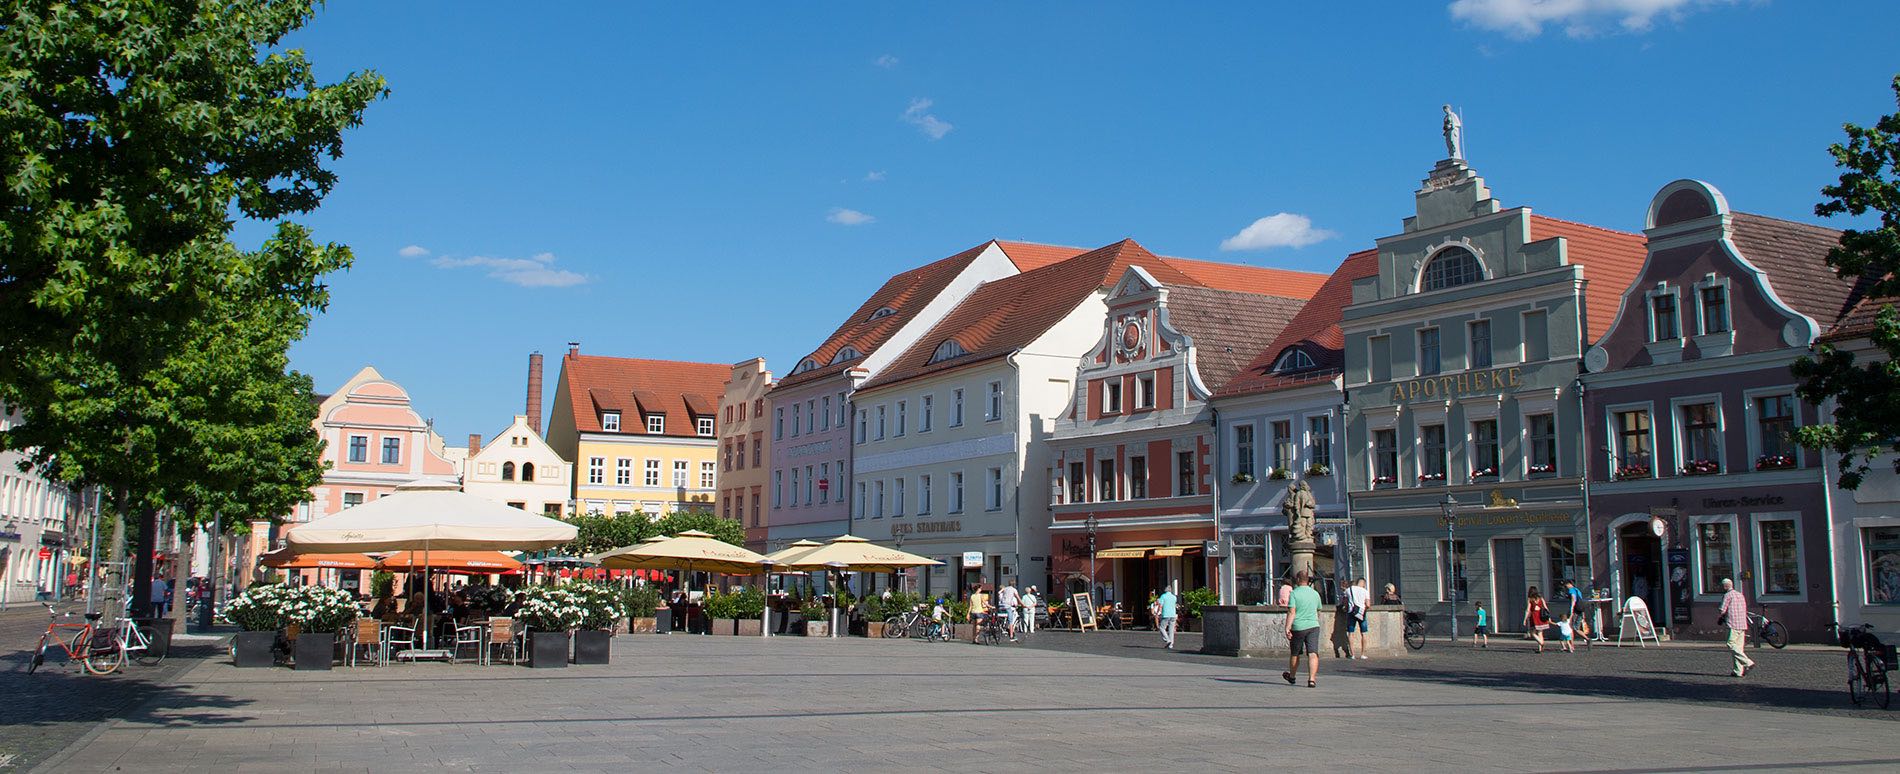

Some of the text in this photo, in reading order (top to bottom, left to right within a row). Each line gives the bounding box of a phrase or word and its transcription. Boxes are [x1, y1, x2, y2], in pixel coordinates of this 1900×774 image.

[1393, 367, 1522, 401] APOTHEKE
[1702, 493, 1785, 509] Uhren-Service
[916, 520, 961, 533] STADTHAUS
